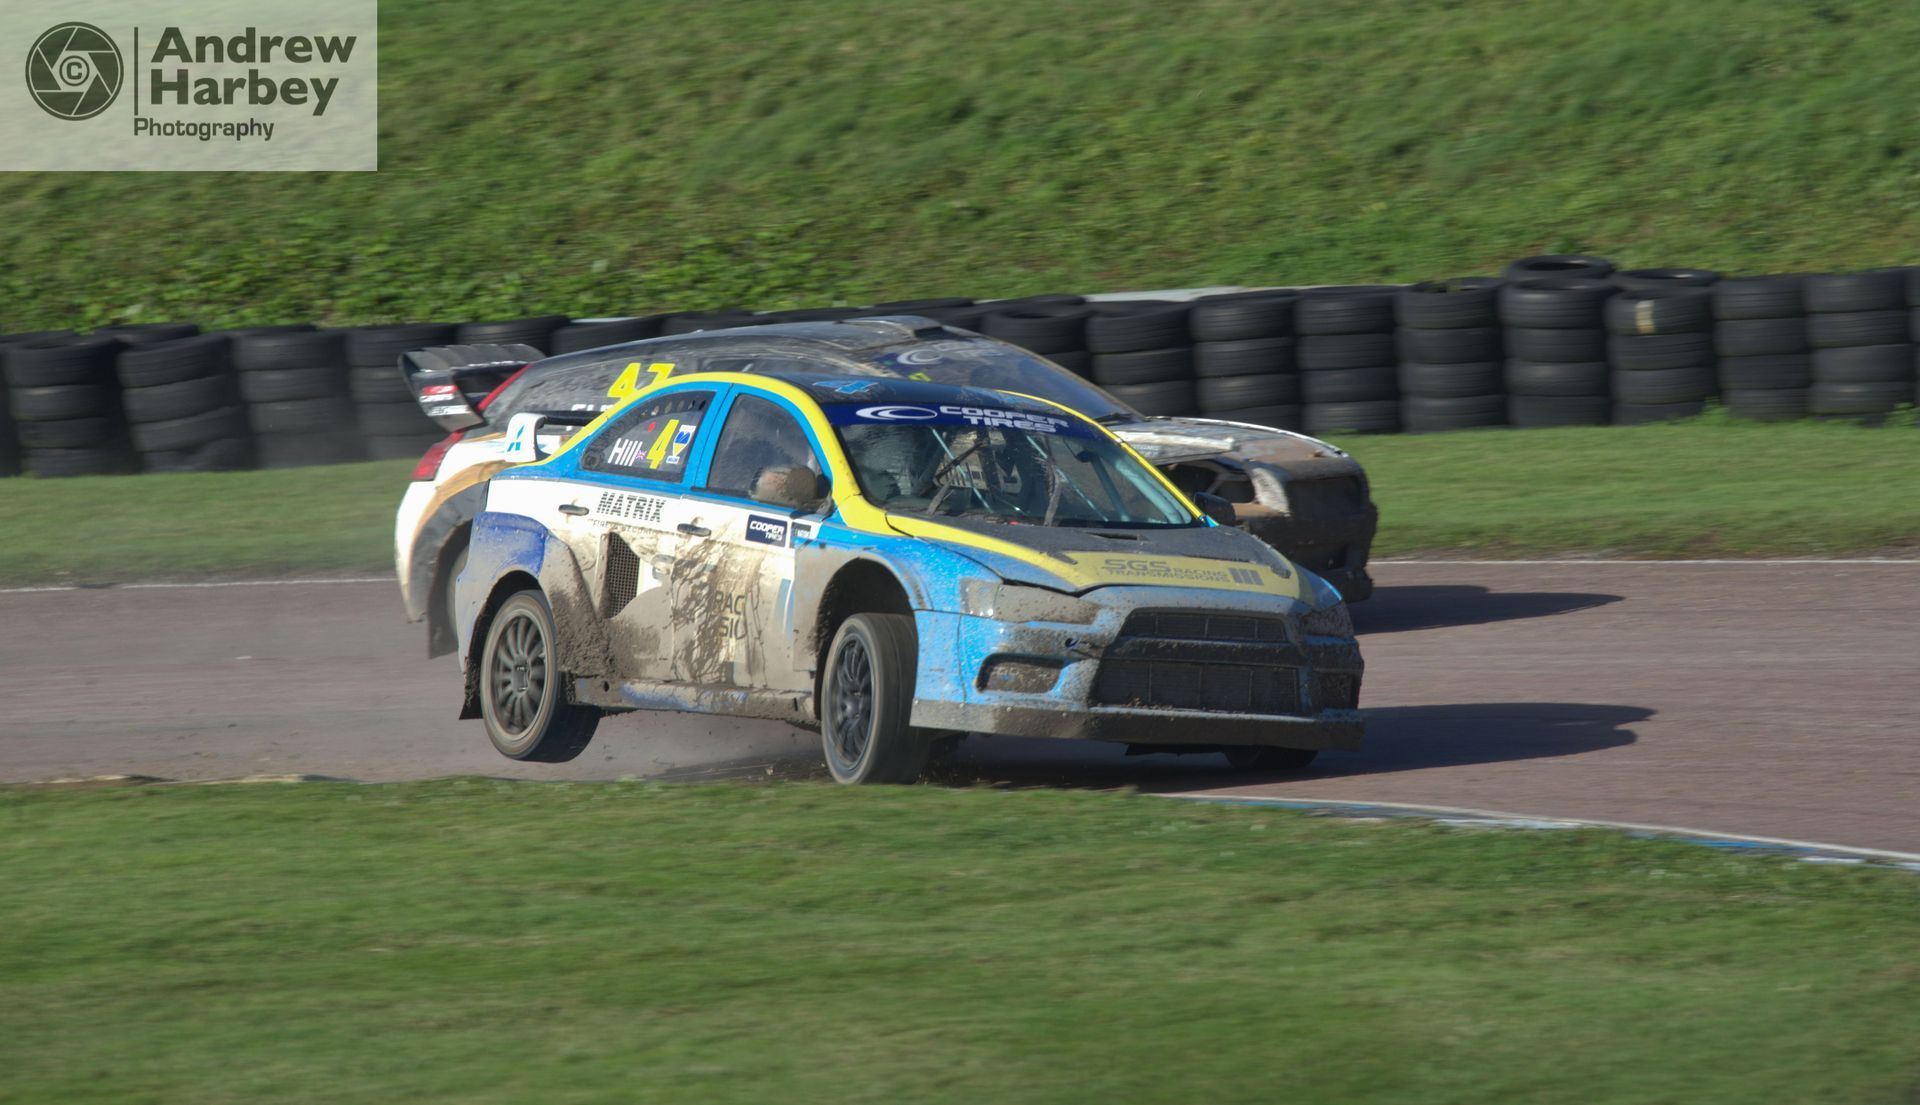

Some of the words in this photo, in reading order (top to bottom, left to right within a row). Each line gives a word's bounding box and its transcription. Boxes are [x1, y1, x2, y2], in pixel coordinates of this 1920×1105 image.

[607, 362, 676, 399] 47
[939, 405, 1070, 428] COOPER
[963, 415, 1057, 433] TIRES
[607, 438, 643, 467] Hill
[646, 419, 679, 470] 4
[596, 492, 667, 522] MATRIX
[749, 520, 785, 535] COOPER
[765, 531, 783, 541] TIRES
[1101, 559, 1172, 572] SGS
